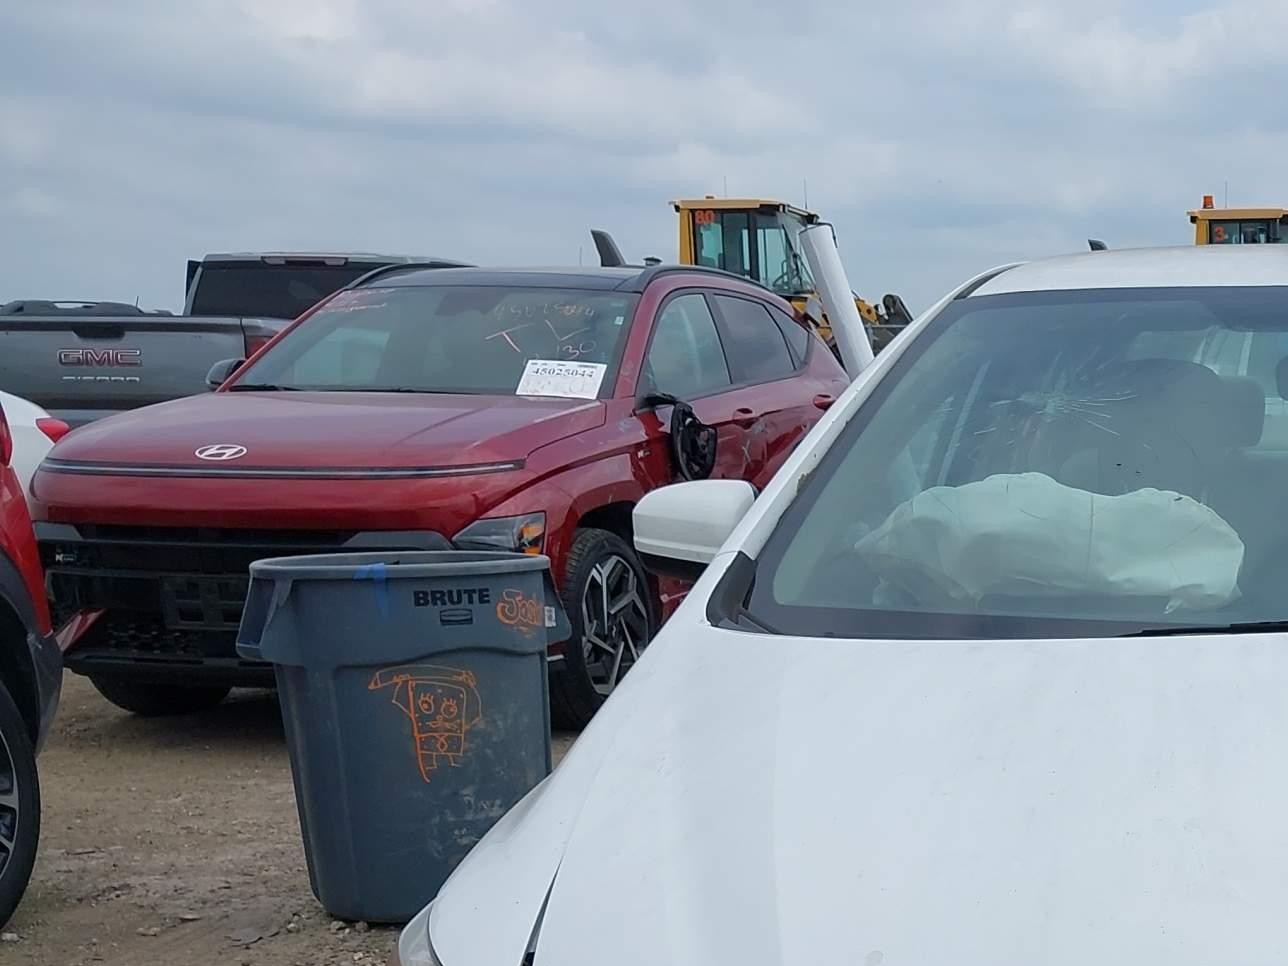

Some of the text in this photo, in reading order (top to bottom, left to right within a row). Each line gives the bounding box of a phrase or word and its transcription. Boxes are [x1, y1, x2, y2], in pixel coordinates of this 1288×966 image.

[57, 349, 142, 366] GMC
[532, 367, 595, 378] 45025044
[413, 587, 491, 607] BRUTE
